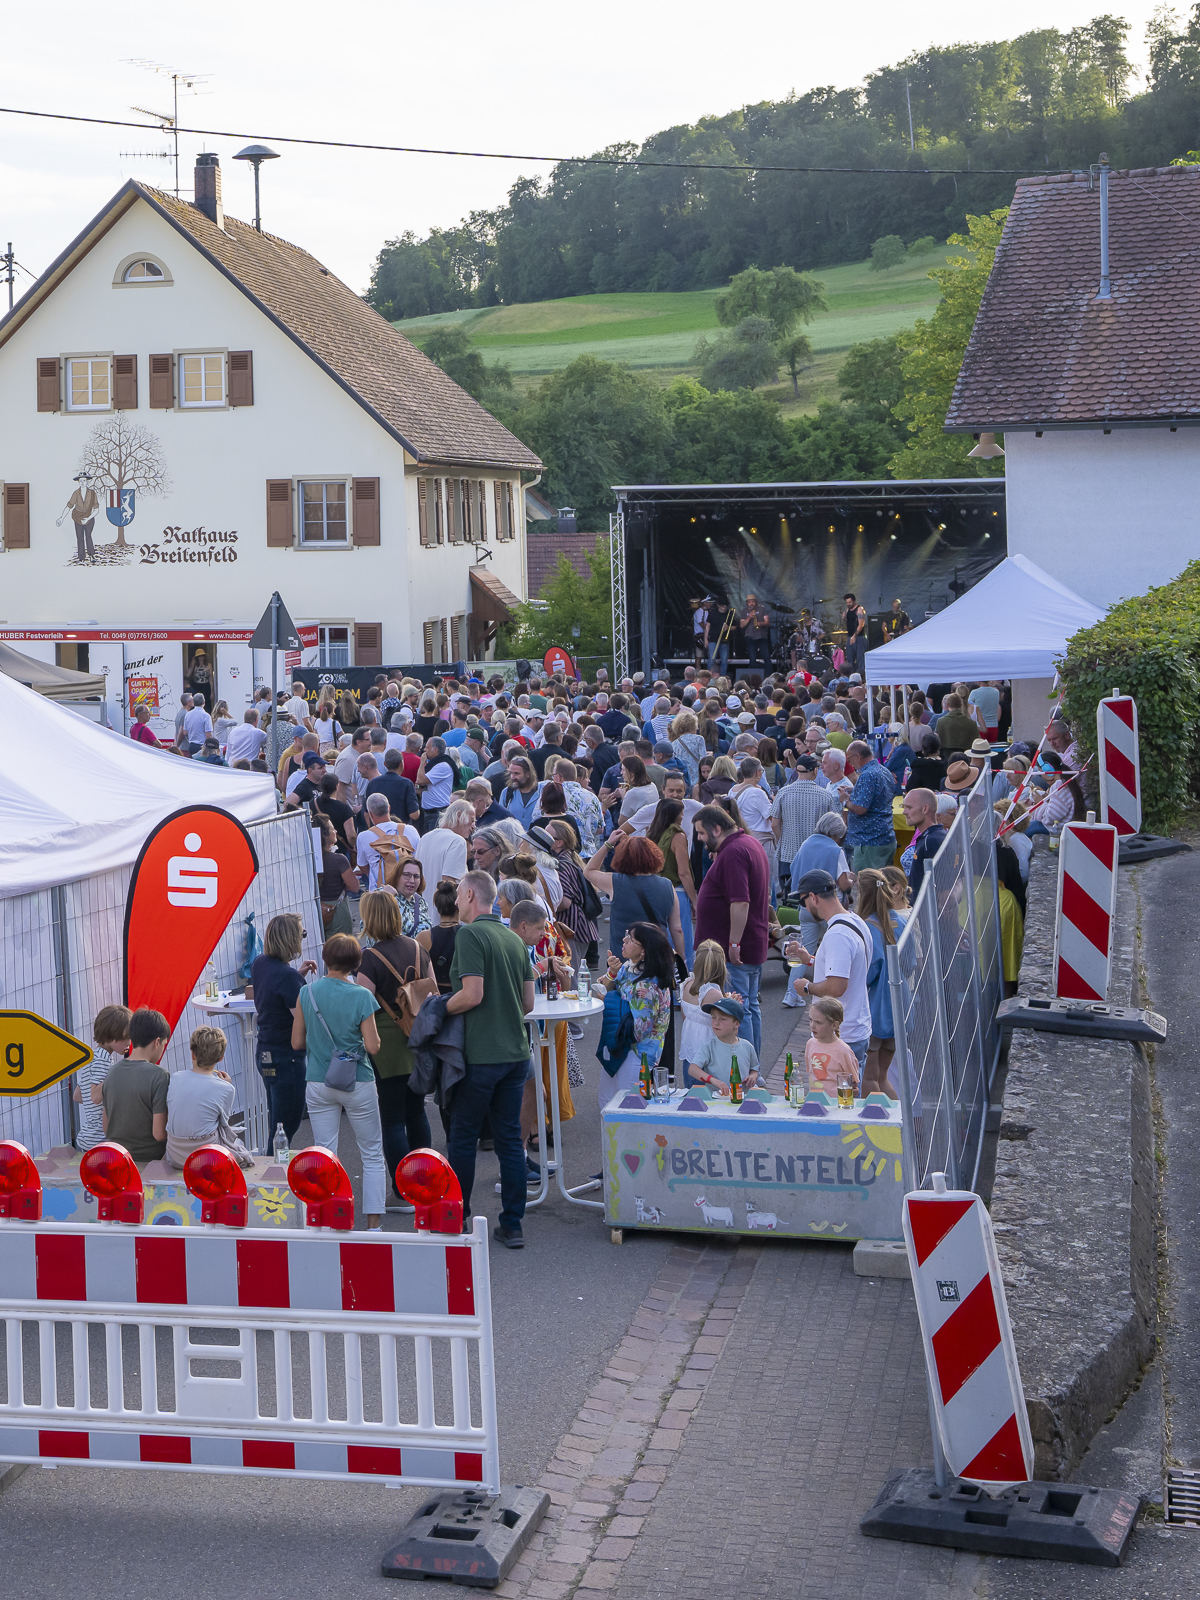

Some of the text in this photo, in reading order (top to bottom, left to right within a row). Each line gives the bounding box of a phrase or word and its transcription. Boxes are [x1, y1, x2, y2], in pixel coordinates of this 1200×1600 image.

[162, 526, 239, 546] Rathaus
[139, 543, 238, 567] Breitenfeld
[25, 632, 64, 640] Festverleih
[99, 632, 168, 641] Tel. 0049 (0)7761/3600
[147, 654, 164, 666] der
[671, 1148, 877, 1187] BREITENFELD
